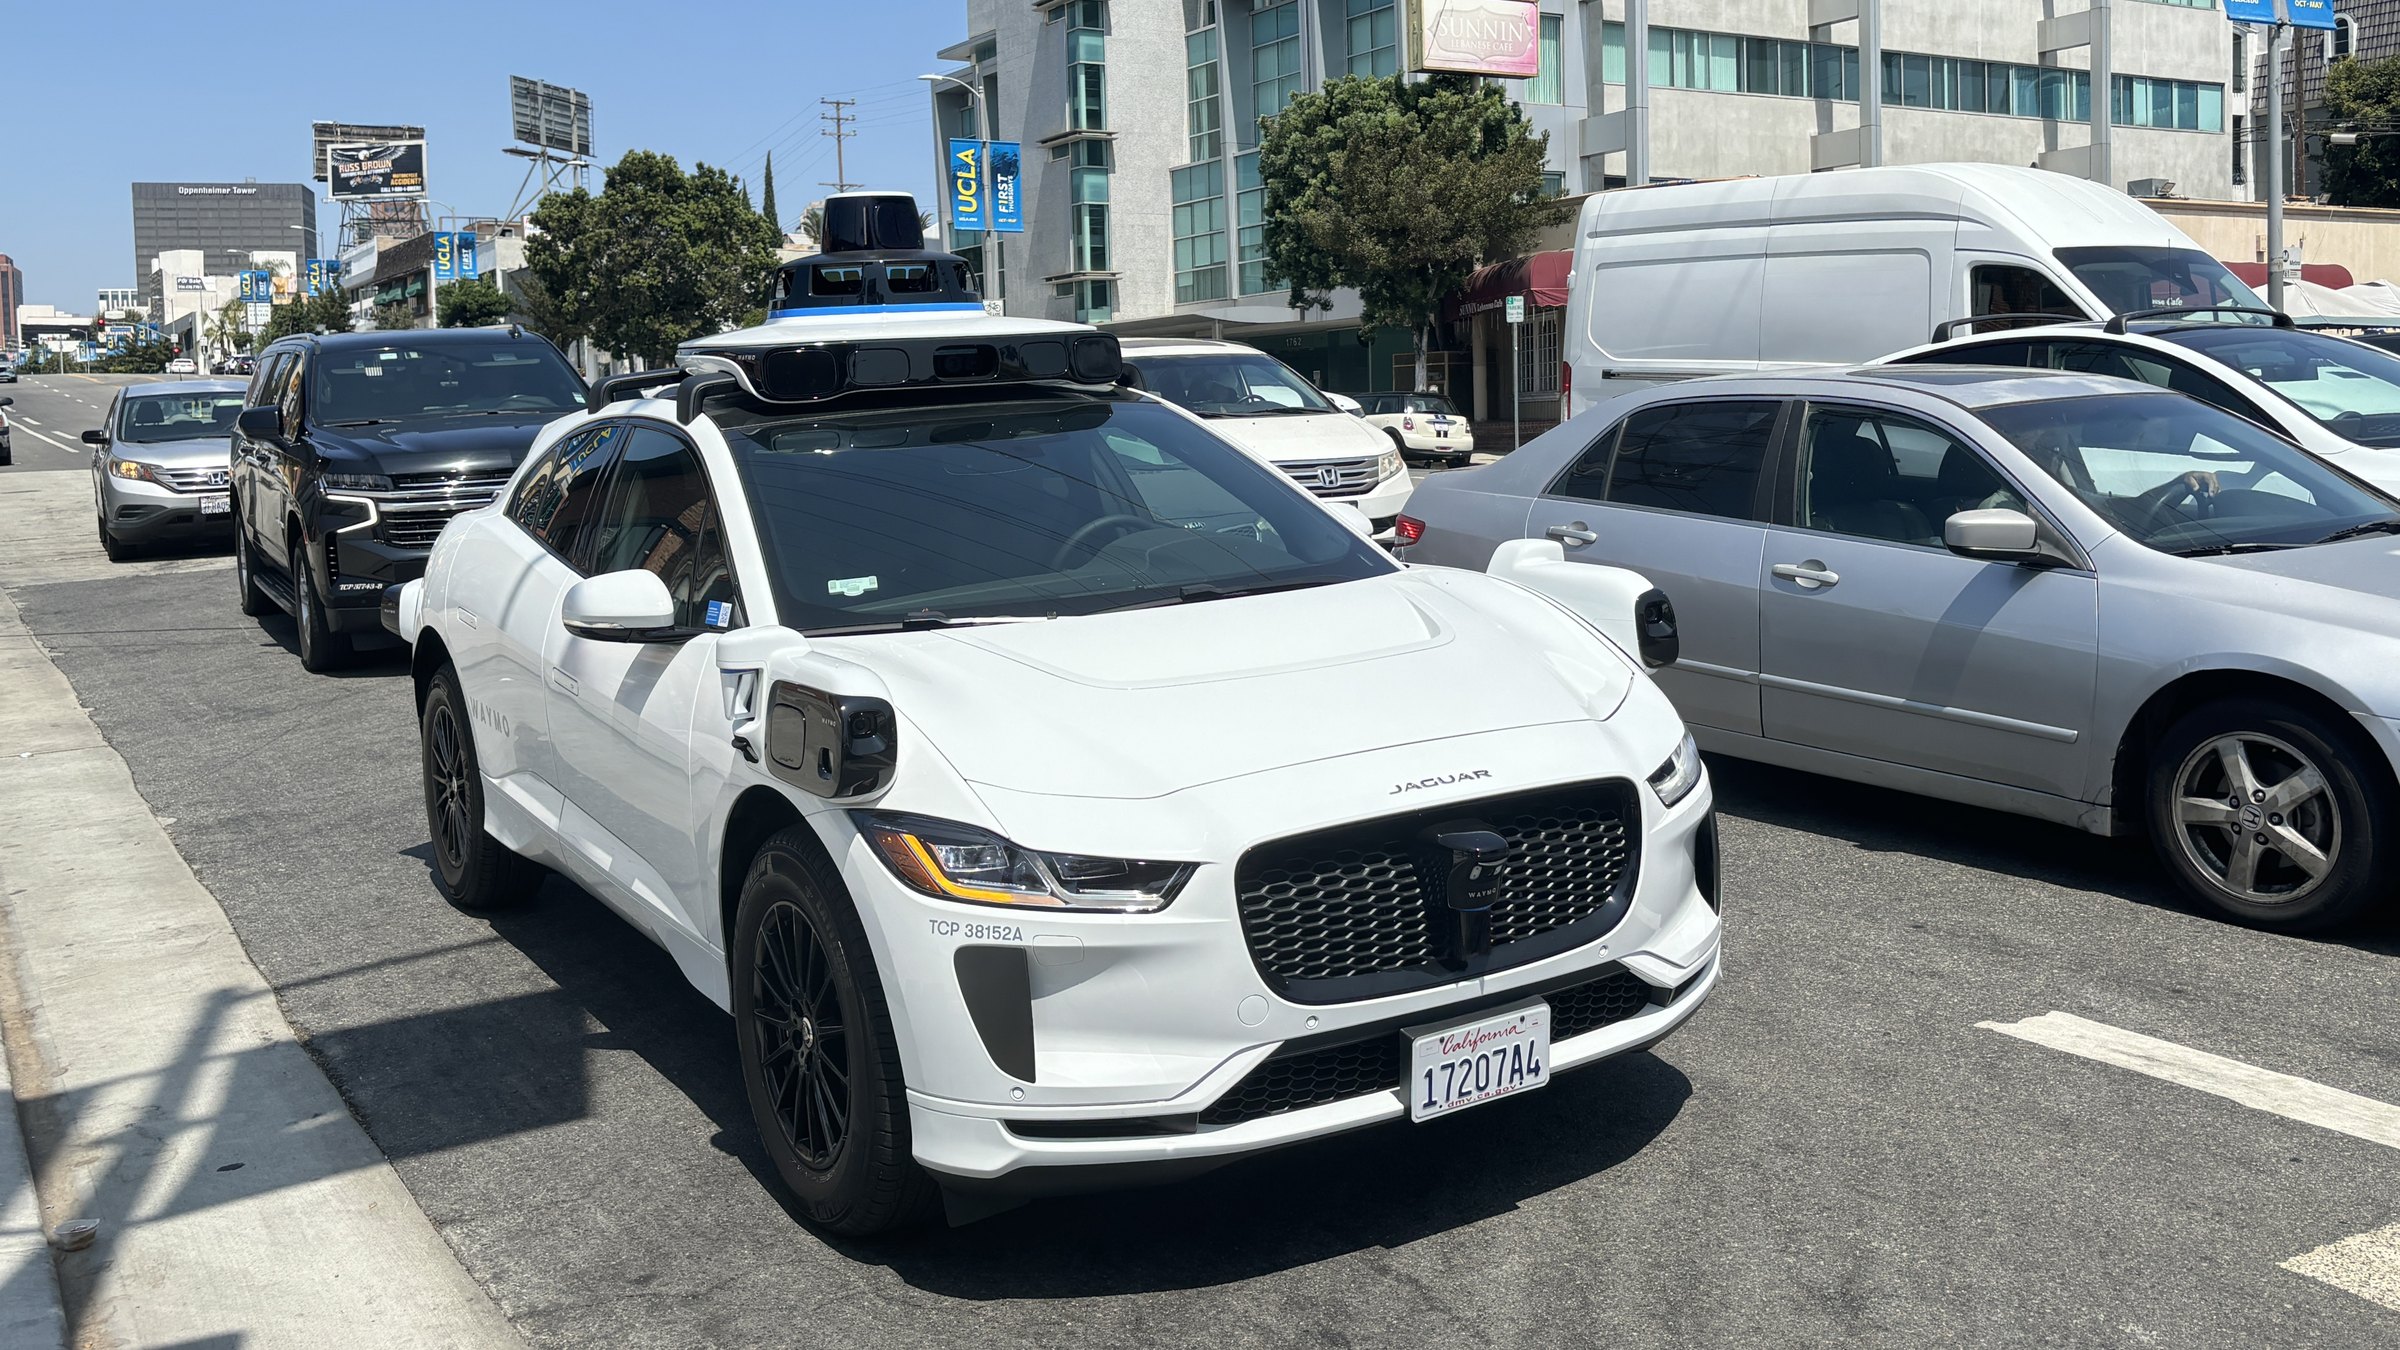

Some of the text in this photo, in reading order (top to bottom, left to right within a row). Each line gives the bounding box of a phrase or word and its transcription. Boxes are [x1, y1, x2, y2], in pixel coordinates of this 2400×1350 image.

[1438, 16, 1524, 42] SUNNIN
[1451, 40, 1513, 52] LEBANESE CAFE
[339, 160, 392, 173] RUSS BROWN
[178, 186, 256, 195] Oppenheimer Tower
[956, 148, 978, 213] UCLA
[998, 174, 1008, 213] FIRST
[438, 236, 451, 270] UCLA
[242, 273, 250, 296] UCLA
[2166, 297, 2183, 306] Cafe
[470, 696, 510, 738] WAYMO
[1388, 769, 1492, 795] JAGUAR
[1468, 888, 1497, 899] WAYMO
[929, 920, 1023, 941] TCP 38152A
[1442, 1021, 1526, 1055] California
[1422, 1039, 1541, 1109] 17207A4
[1447, 1084, 1517, 1108] dmv.ca.gov
